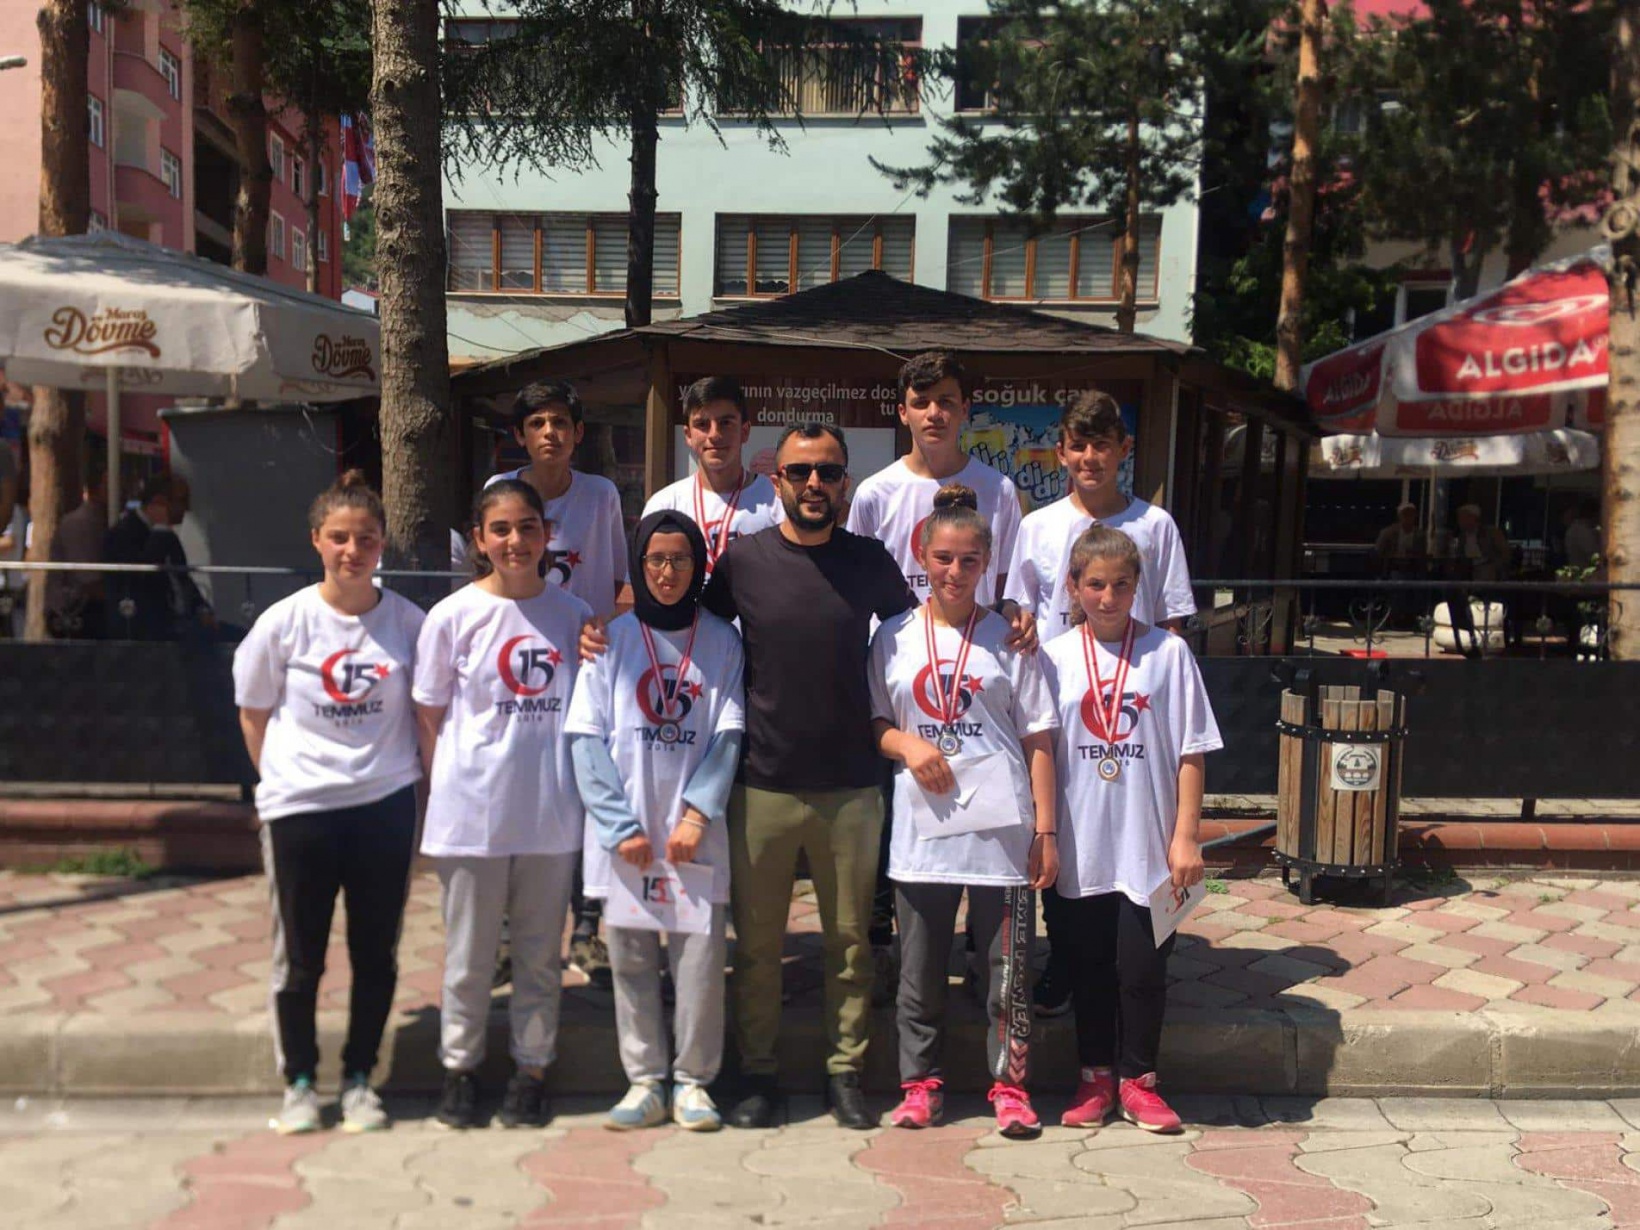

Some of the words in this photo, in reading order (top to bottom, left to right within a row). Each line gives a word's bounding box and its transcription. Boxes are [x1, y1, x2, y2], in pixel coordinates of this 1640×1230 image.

[44, 305, 158, 350] Dövme
[312, 333, 373, 373] Dövme
[1456, 338, 1597, 380] ALGIDA
[777, 383, 866, 403] vazgeçilmez
[871, 384, 896, 399] dos
[972, 384, 1046, 407] soğuk
[757, 406, 834, 423] dondurma
[880, 402, 895, 416] tu
[518, 648, 555, 687] 15
[342, 663, 378, 699] 15
[311, 700, 384, 718] TEMMUZ
[495, 698, 561, 715] TEMMUZ
